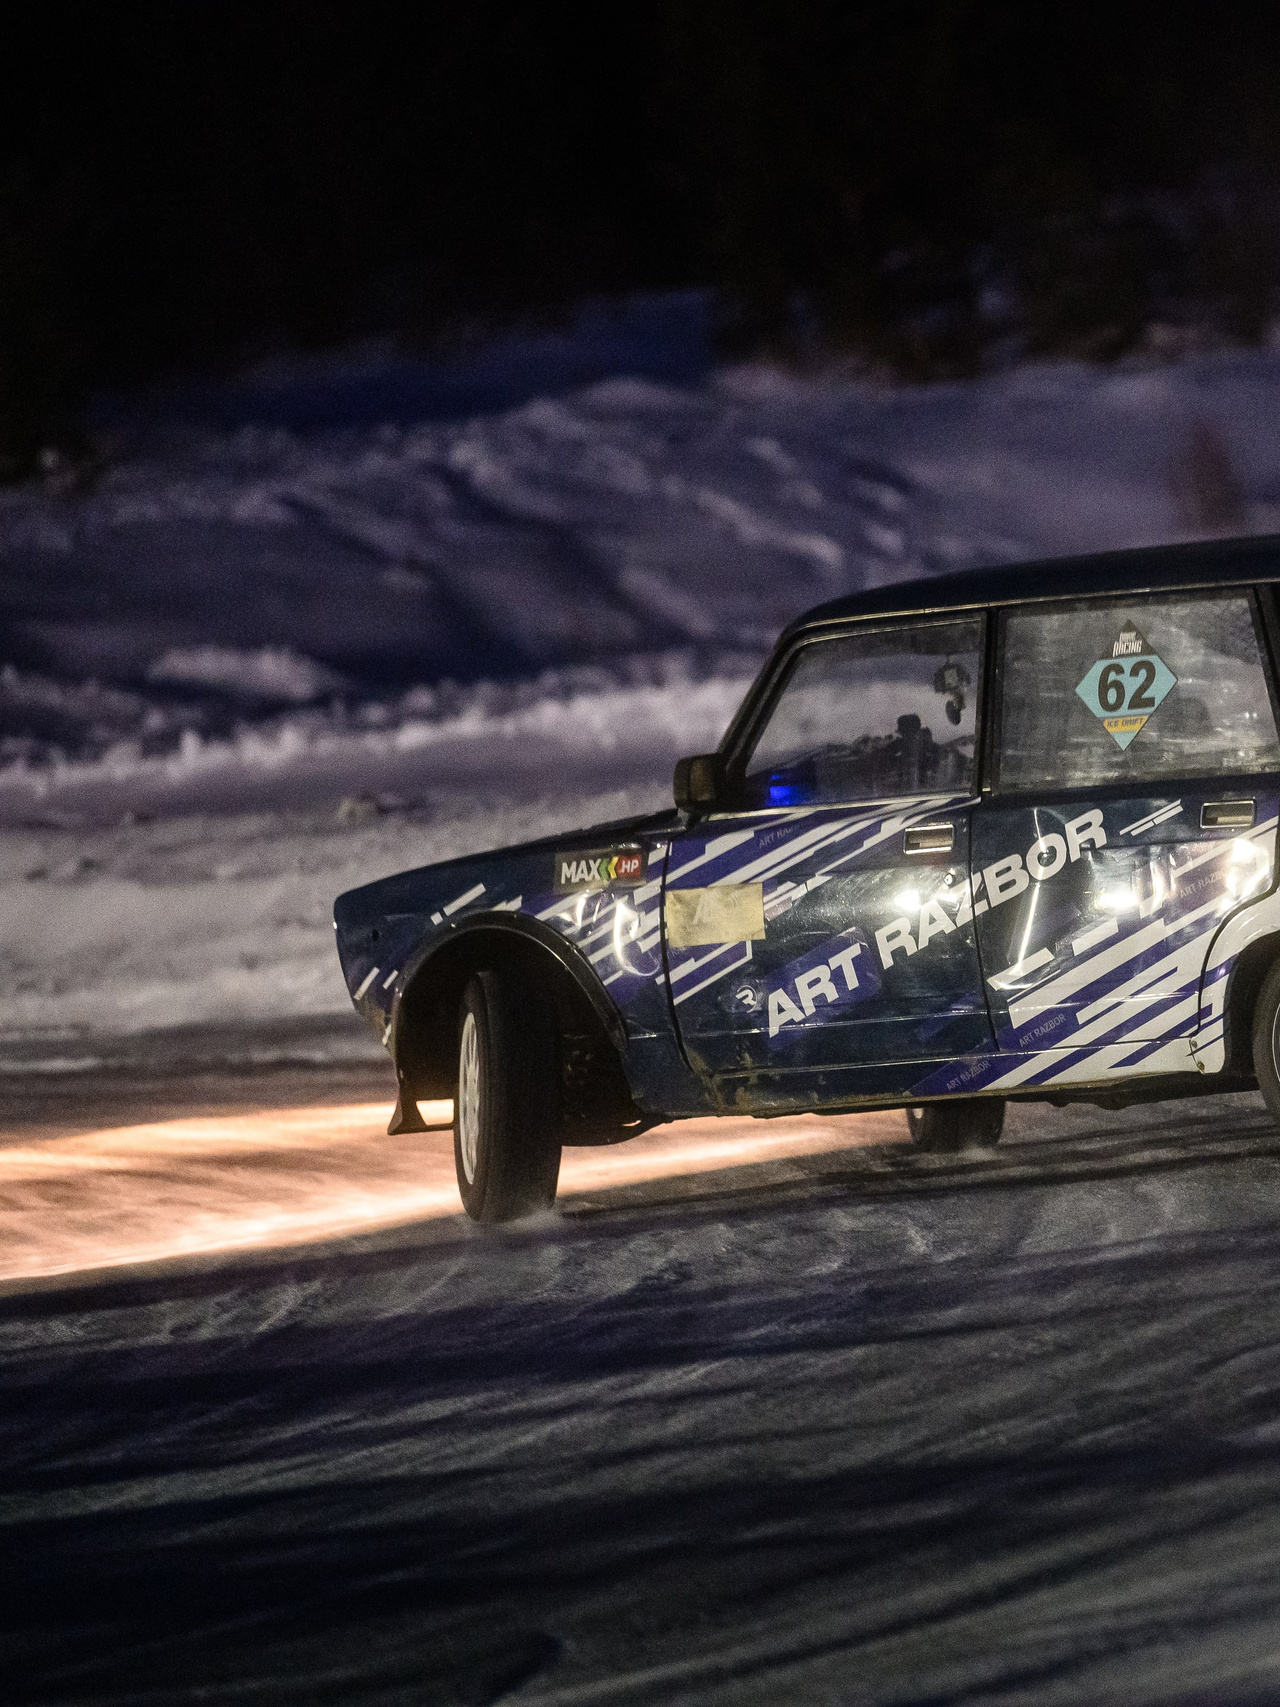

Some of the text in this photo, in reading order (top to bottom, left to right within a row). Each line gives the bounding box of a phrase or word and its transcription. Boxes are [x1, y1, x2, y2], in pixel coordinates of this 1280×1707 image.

[1098, 660, 1156, 712] 62
[561, 858, 602, 885] MAX
[768, 808, 1107, 1038] ART RAZBOR
[1019, 1013, 1067, 1047] ART RAZBOR
[946, 1060, 992, 1090] ART RAZBOR
